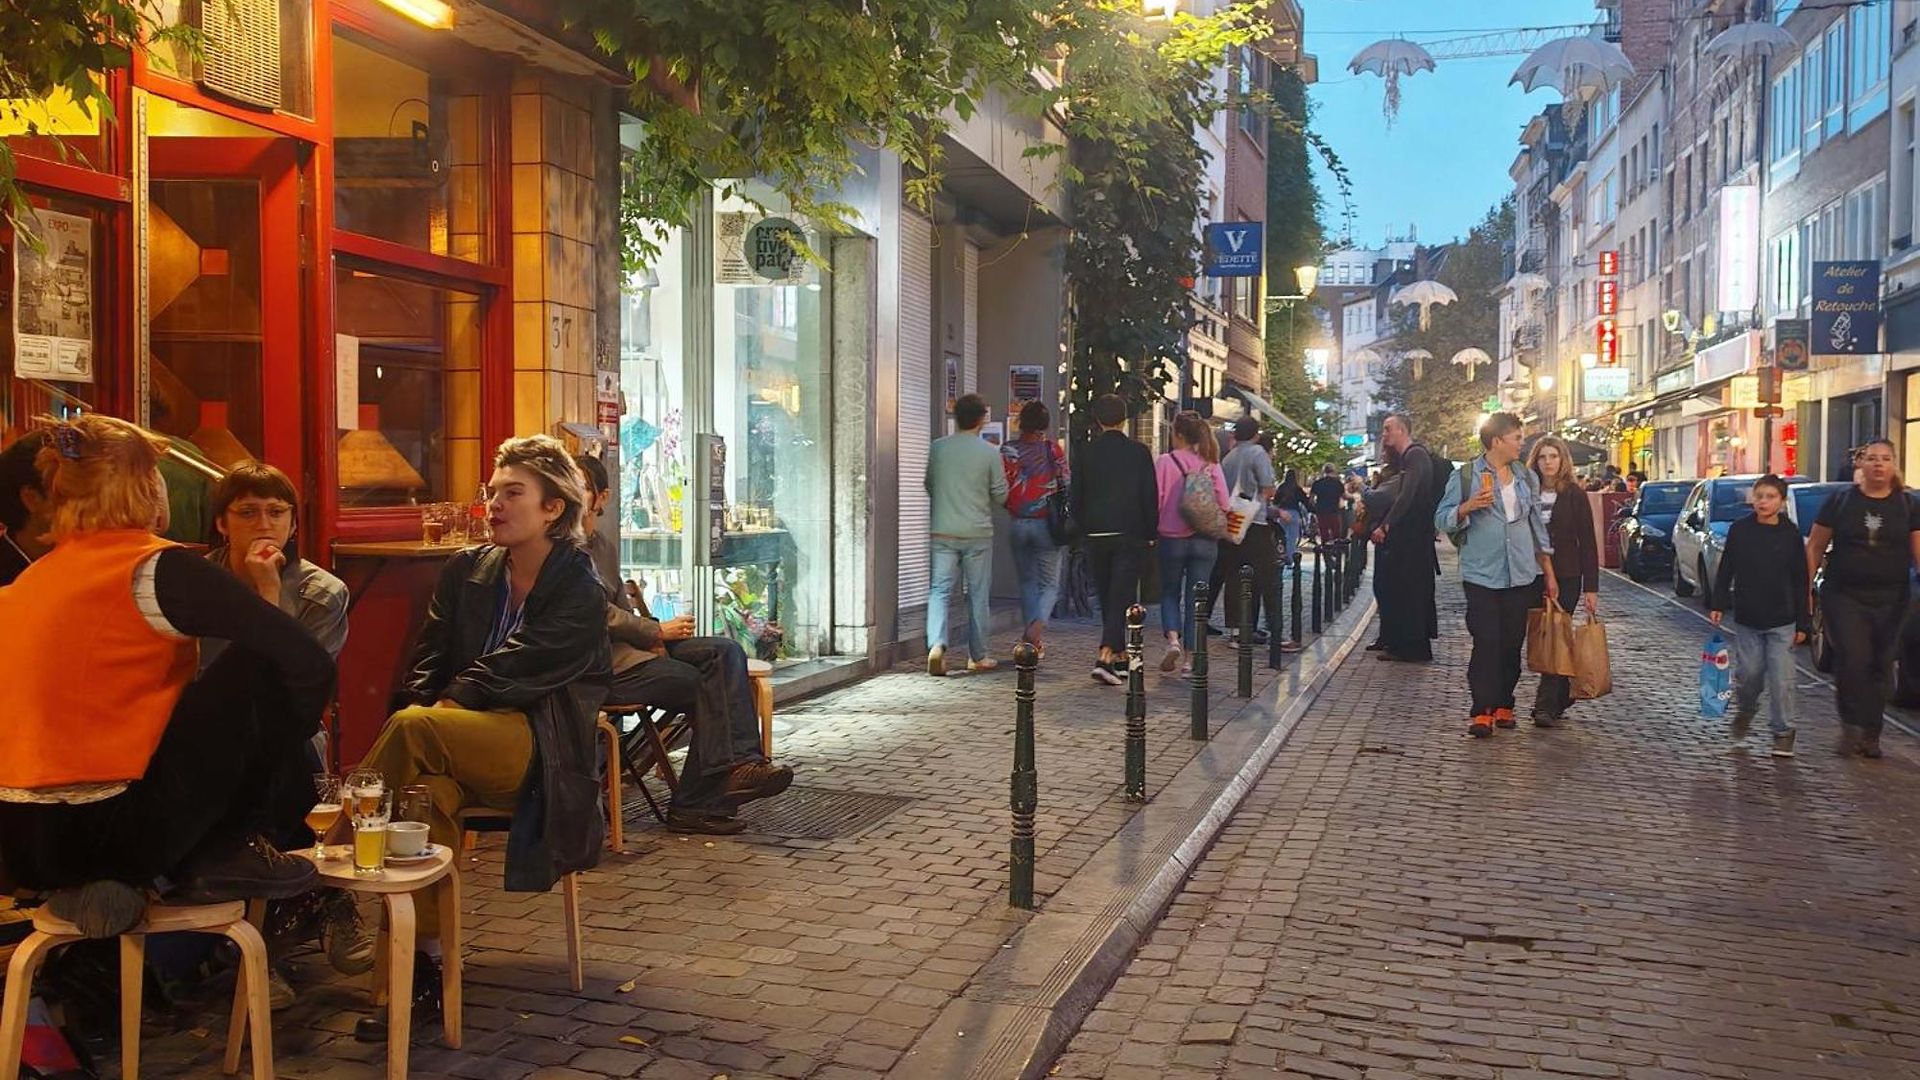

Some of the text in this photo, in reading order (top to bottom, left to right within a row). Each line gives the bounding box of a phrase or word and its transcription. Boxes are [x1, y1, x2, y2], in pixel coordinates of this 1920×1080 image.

[48, 218, 69, 232] EXPO
[1224, 230, 1248, 252] V
[1824, 266, 1867, 277] Atelier
[1837, 283, 1854, 294] de
[1815, 300, 1876, 312] Retouche
[552, 317, 572, 349] 37
